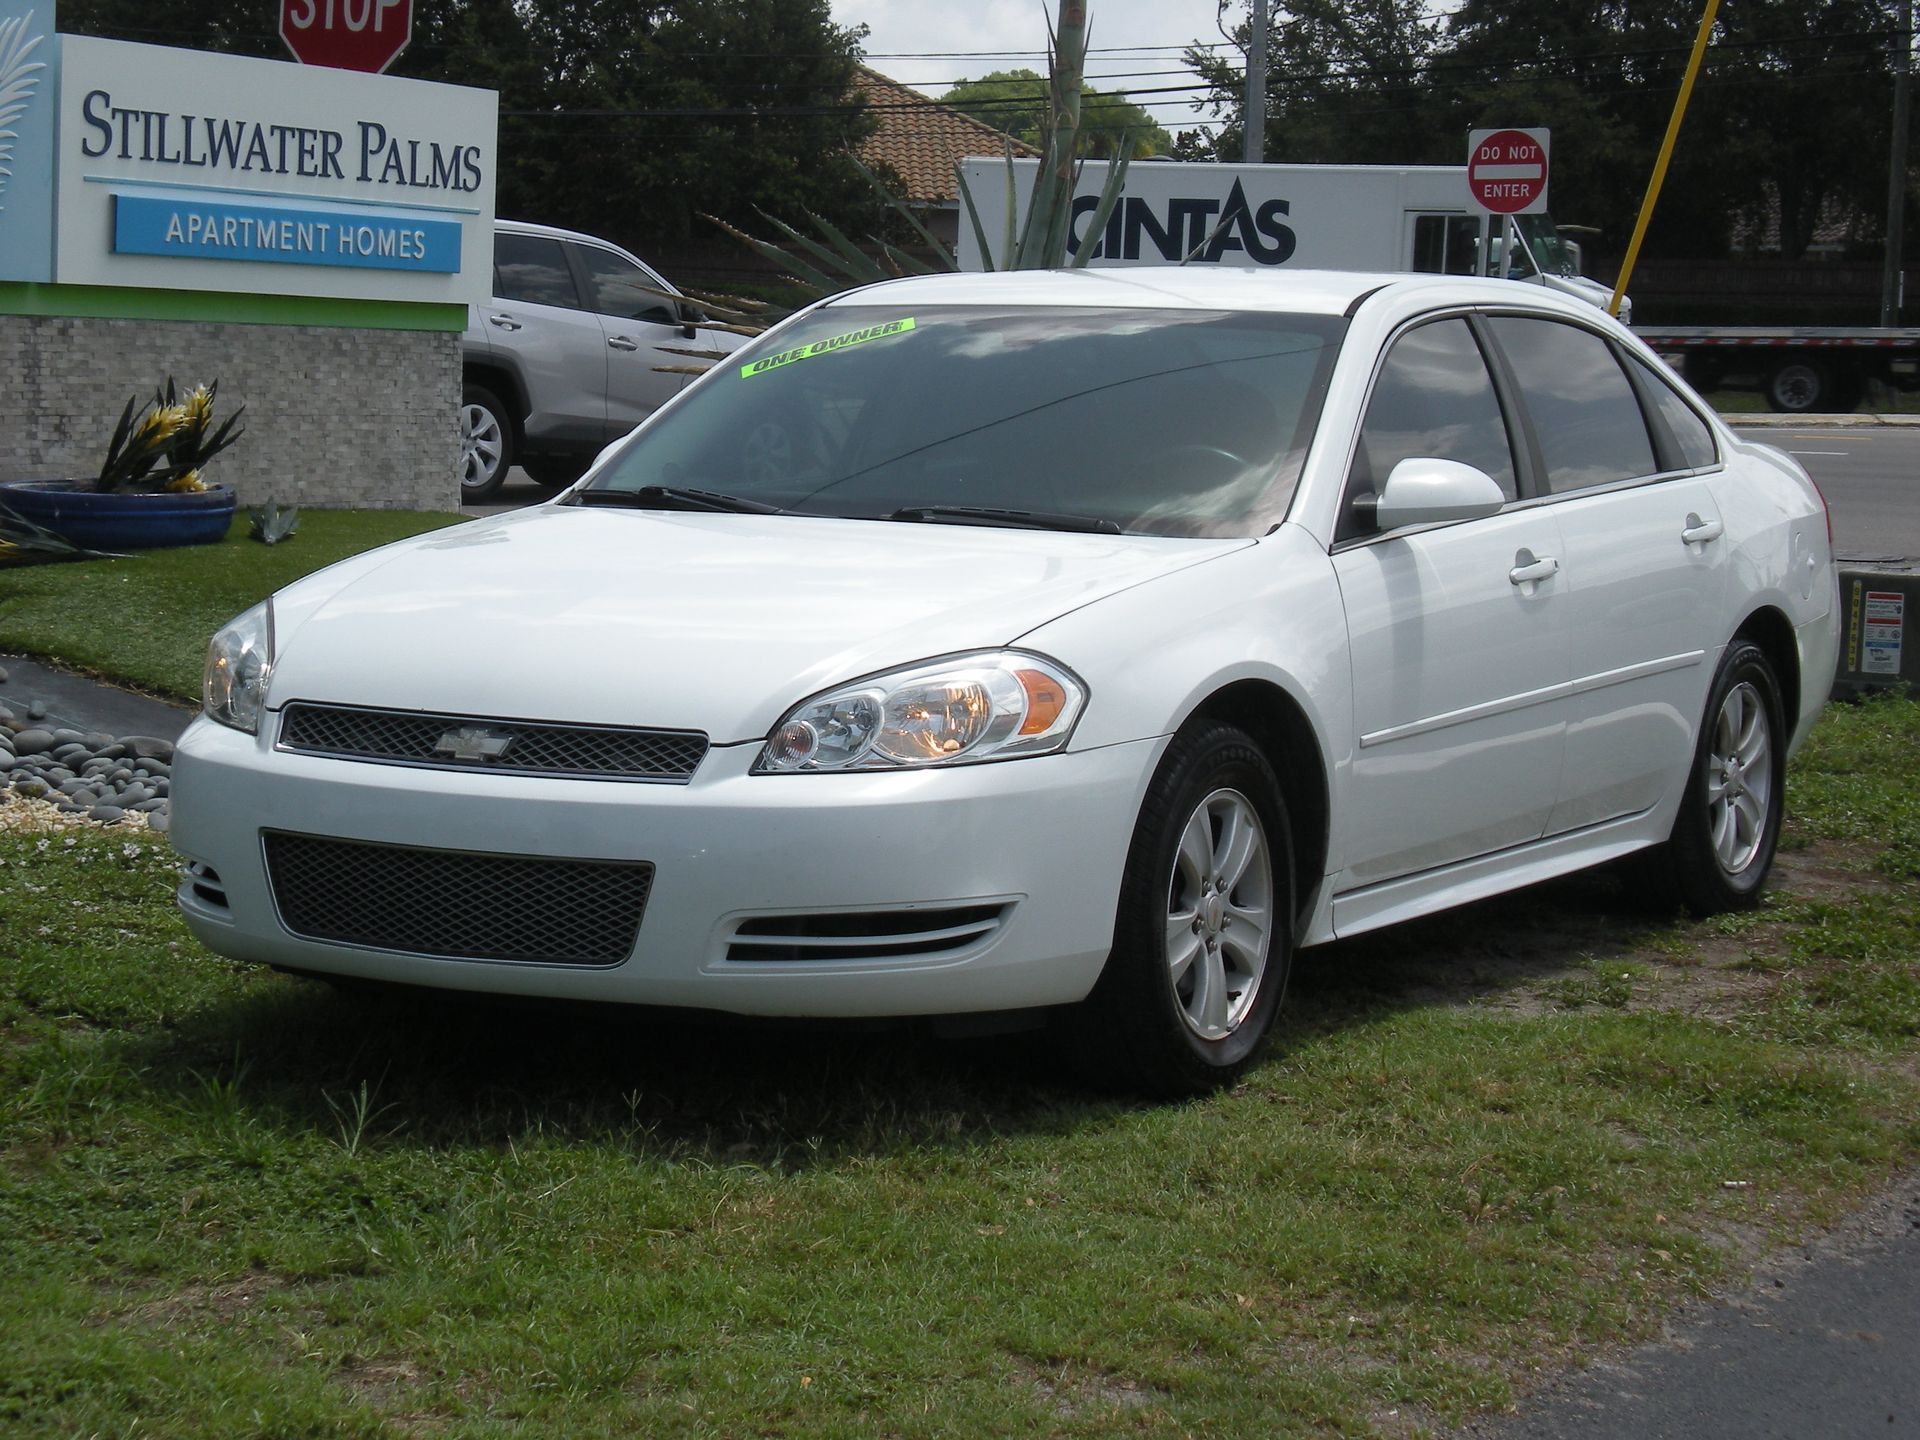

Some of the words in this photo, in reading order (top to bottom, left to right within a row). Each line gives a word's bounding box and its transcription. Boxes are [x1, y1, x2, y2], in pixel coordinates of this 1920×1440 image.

[290, 0, 400, 32] STOP
[82, 90, 345, 179] STILLWATER
[356, 121, 482, 192] PALMS
[1481, 146, 1500, 160] DO
[1509, 146, 1537, 159] NOT
[1484, 184, 1529, 198] ENTER
[165, 212, 330, 253] APARTMENT
[338, 224, 426, 260] HOMES
[1066, 175, 1297, 266] CINTAS
[752, 347, 805, 373] ONE
[810, 321, 904, 354] OWNER
